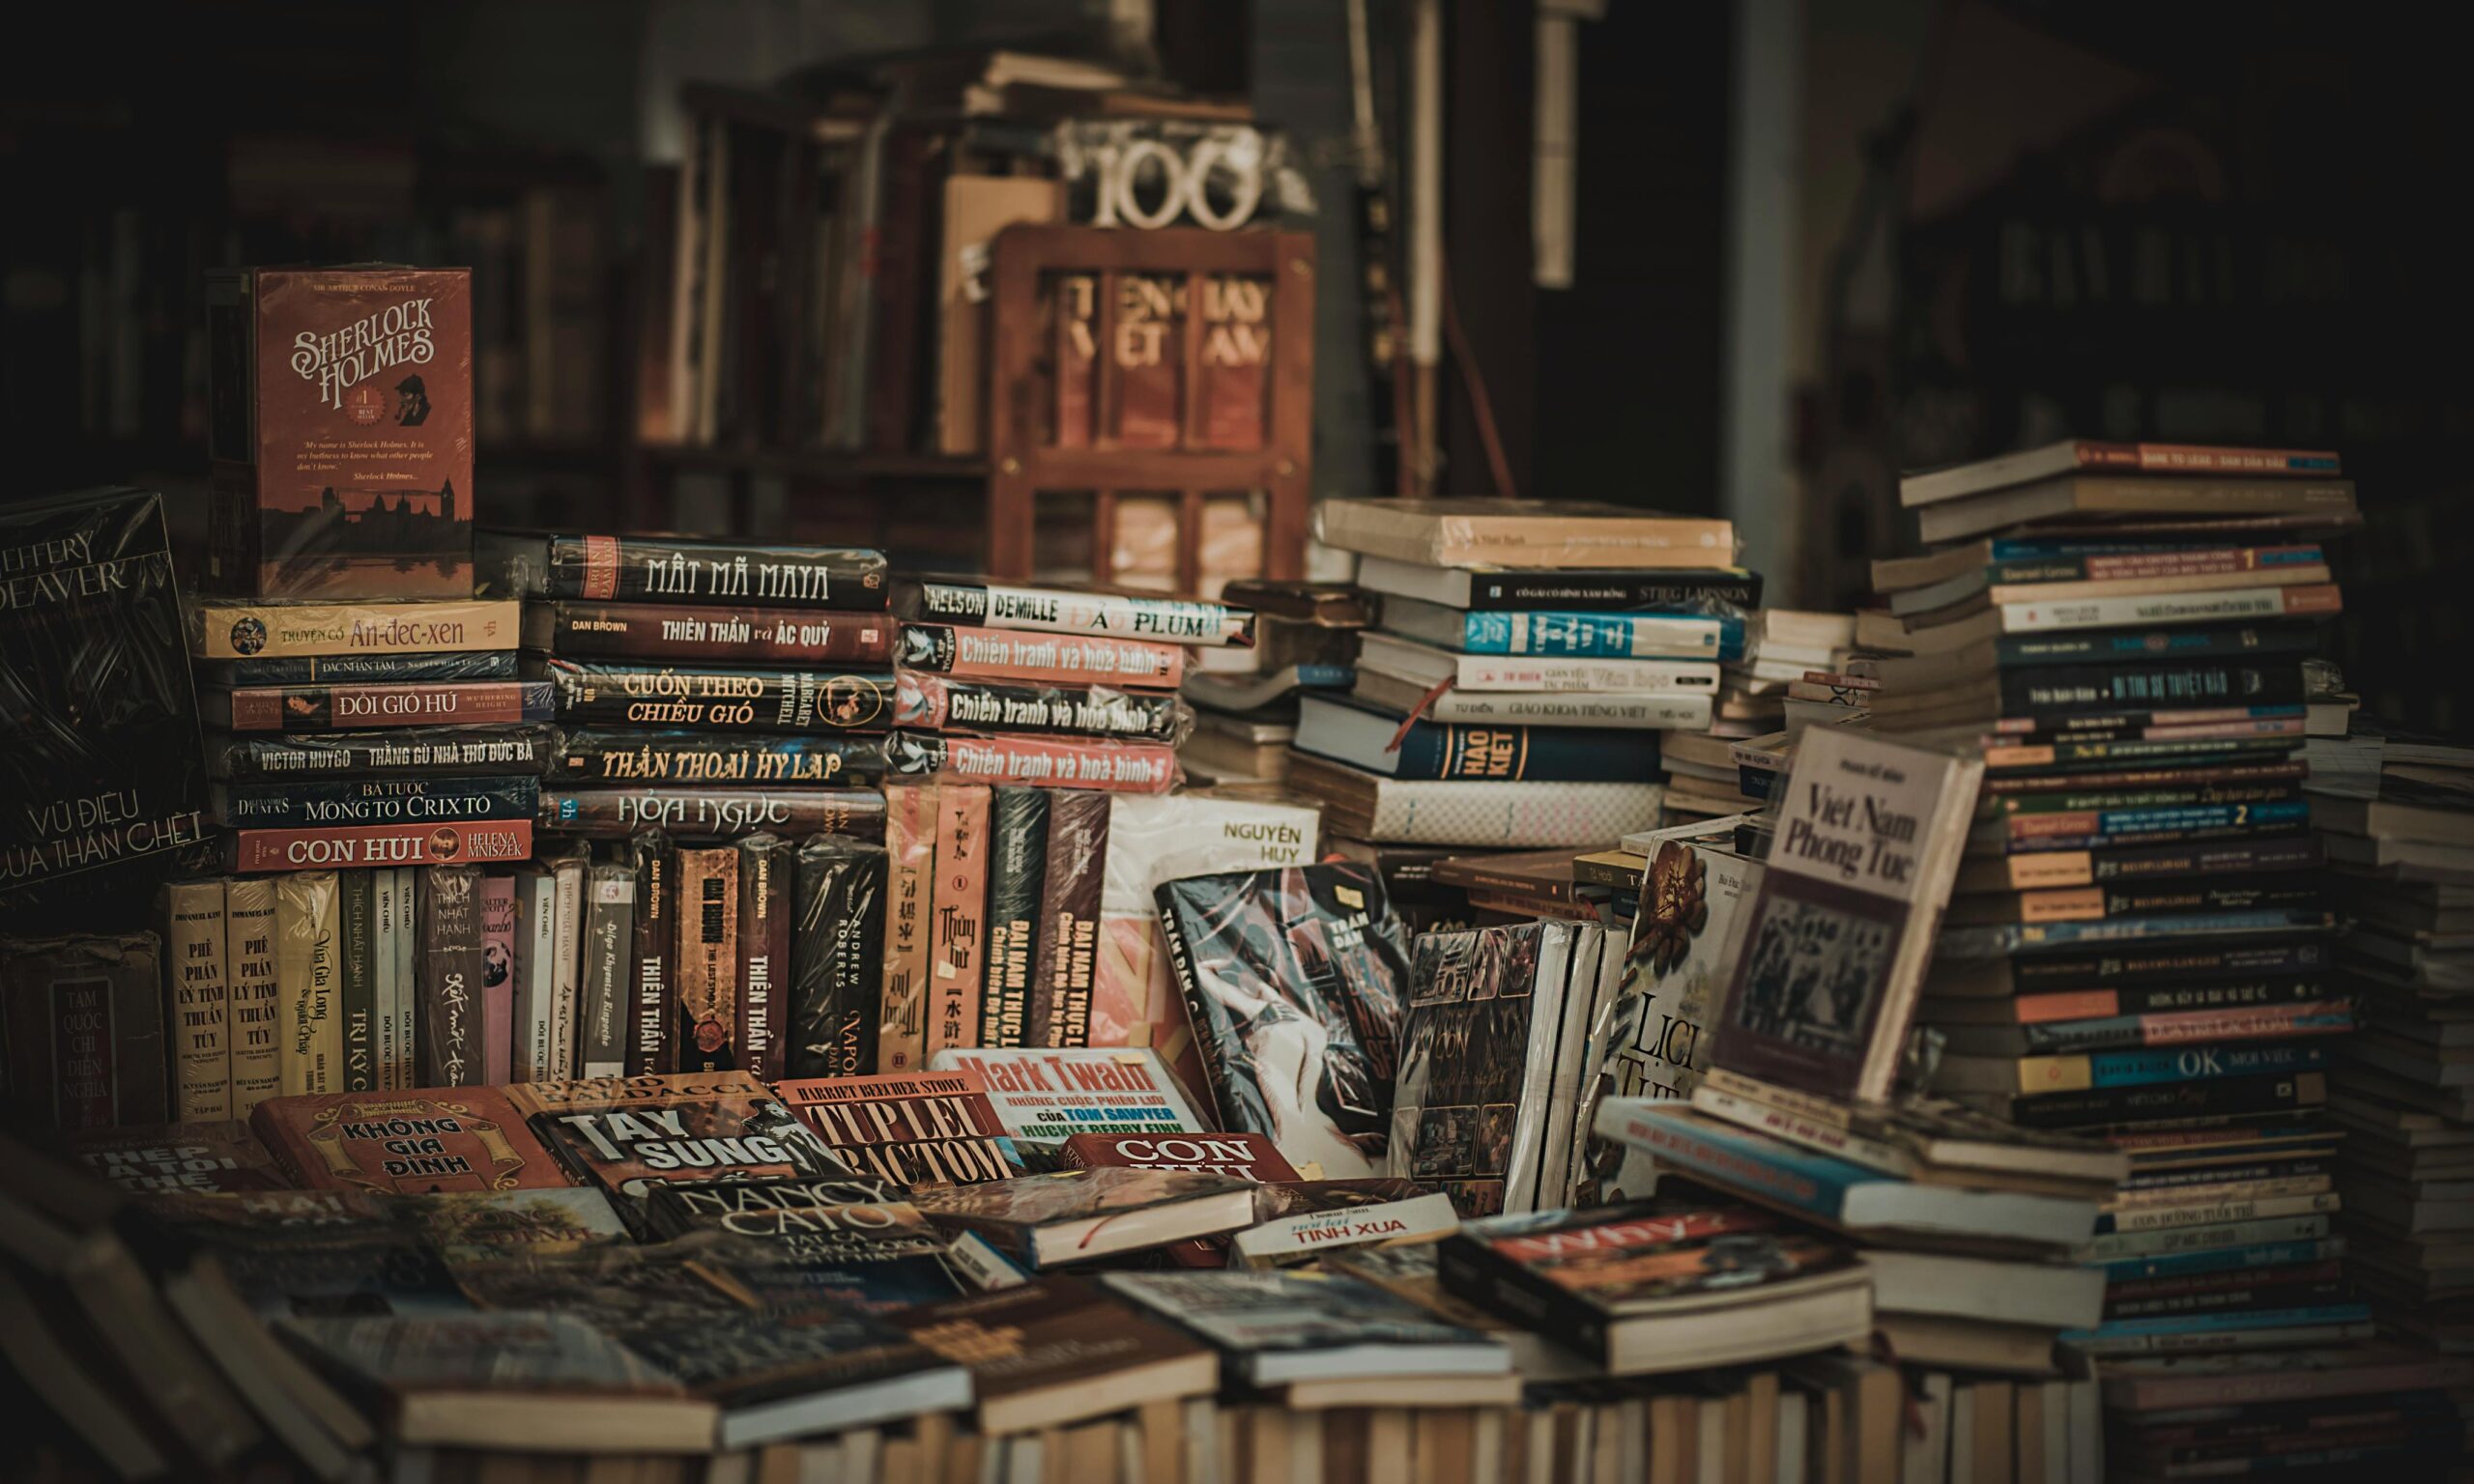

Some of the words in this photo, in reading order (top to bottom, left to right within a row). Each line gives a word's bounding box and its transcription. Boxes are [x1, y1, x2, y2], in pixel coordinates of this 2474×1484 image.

[1093, 135, 1262, 231] 100
[291, 299, 433, 380] SHERLOCK
[319, 328, 435, 410] HOLMES
[318, 442, 338, 450] name
[348, 441, 379, 449] Sherlock
[350, 451, 369, 460] know
[410, 451, 434, 462] people
[353, 471, 386, 480] Sherlock
[2243, 548, 2255, 569] 1
[708, 556, 748, 596] MÃ
[758, 563, 830, 600] MAYA
[1639, 585, 1681, 603] STIEG
[929, 587, 987, 616] NELSON
[994, 594, 1058, 623] DEMILLE
[1134, 612, 1205, 638] PLUM
[572, 620, 591, 631] DAN
[593, 621, 627, 633] BROWN
[662, 617, 705, 642] THIÊN
[711, 615, 750, 643] THẦN
[754, 628, 773, 641] và
[1013, 641, 1056, 669] tranh
[1061, 644, 1079, 671] và
[699, 676, 764, 699] THEO
[776, 673, 794, 726] MITCHELL
[795, 672, 816, 728] MARGARET
[339, 690, 378, 716] ĐỒI
[383, 692, 420, 715] GIÓ
[628, 696, 704, 723] CHIỀU
[709, 698, 755, 724] GIÓ
[951, 692, 1003, 723] Chiến
[1004, 699, 1050, 727] tranh
[1051, 701, 1073, 728] và
[262, 752, 305, 771] VICTOR
[309, 750, 351, 769] HUYGO
[413, 744, 430, 764] GÙ
[433, 743, 459, 763] NHÀ
[1008, 752, 1053, 779] tranh
[1056, 753, 1077, 780] và
[27, 799, 72, 838] VŨ
[1856, 794, 1916, 843] Nam
[2234, 804, 2249, 825] 2
[287, 840, 357, 864] CON
[363, 835, 424, 861] HỦI
[468, 832, 518, 846] HELENA
[468, 844, 523, 859] MNISZEK
[1784, 818, 1863, 879] Phong
[1259, 845, 1300, 864] HUY
[650, 860, 661, 881] DAN
[758, 859, 767, 883] DAN
[649, 882, 660, 919] BROWN
[703, 877, 725, 901] DAN
[757, 883, 767, 919] BROWN
[352, 888, 364, 923] THÍCH
[605, 923, 618, 951] Dilgo
[702, 902, 724, 945] BROWN
[1058, 911, 1075, 945] Chính
[188, 938, 213, 959] PHÊ
[244, 934, 269, 956] PHÊ
[312, 929, 331, 965] Vua
[708, 949, 717, 965] THE
[835, 919, 849, 988] ROBERTS
[850, 919, 863, 985] ANDREW
[990, 926, 1008, 963] Chính
[185, 962, 217, 982] PHÁN
[241, 959, 273, 978] PHÁN
[312, 965, 331, 987] Gia
[602, 952, 618, 997] Khyentse
[642, 956, 665, 1005] THIÊN
[707, 965, 717, 985] LOST
[748, 955, 773, 1003] THIÊN
[1005, 951, 1029, 987] NAM
[1070, 951, 1093, 989] NAM
[66, 990, 98, 1009] TAM
[197, 984, 224, 1004] TÍNH
[234, 983, 250, 1002] LÝ
[250, 980, 278, 1000] TÍNH
[309, 988, 331, 1022] Long
[62, 1010, 103, 1034] QUỐC
[183, 1000, 223, 1027] THUẦN
[238, 998, 276, 1024] THUẦN
[601, 997, 614, 1047] Rinpoche
[1001, 989, 1026, 1036] THỰC
[1065, 990, 1089, 1036] THỰC
[193, 1030, 217, 1049] TÚY
[246, 1027, 272, 1046] TÚY
[349, 1008, 368, 1043] TRI
[640, 1007, 667, 1053] THẦN
[746, 1006, 775, 1051] THẦN
[955, 1055, 1052, 1094] Mark
[2176, 1048, 2224, 1077] OK
[796, 1085, 857, 1102] HARRIET
[858, 1081, 919, 1098] BEECHER
[921, 1077, 971, 1094] STOWE
[340, 1115, 464, 1142] KHÔNG
[1036, 1107, 1065, 1124] CỦA
[1065, 1107, 1106, 1123] TOM
[1106, 1106, 1176, 1122] SAWYER
[383, 1137, 447, 1158] GIA
[558, 1109, 694, 1161] TAY
[1114, 1138, 1258, 1163] CON
[383, 1154, 475, 1178] ĐÌNH
[677, 1178, 895, 1216] NANCY
[720, 1203, 897, 1237] CATO
